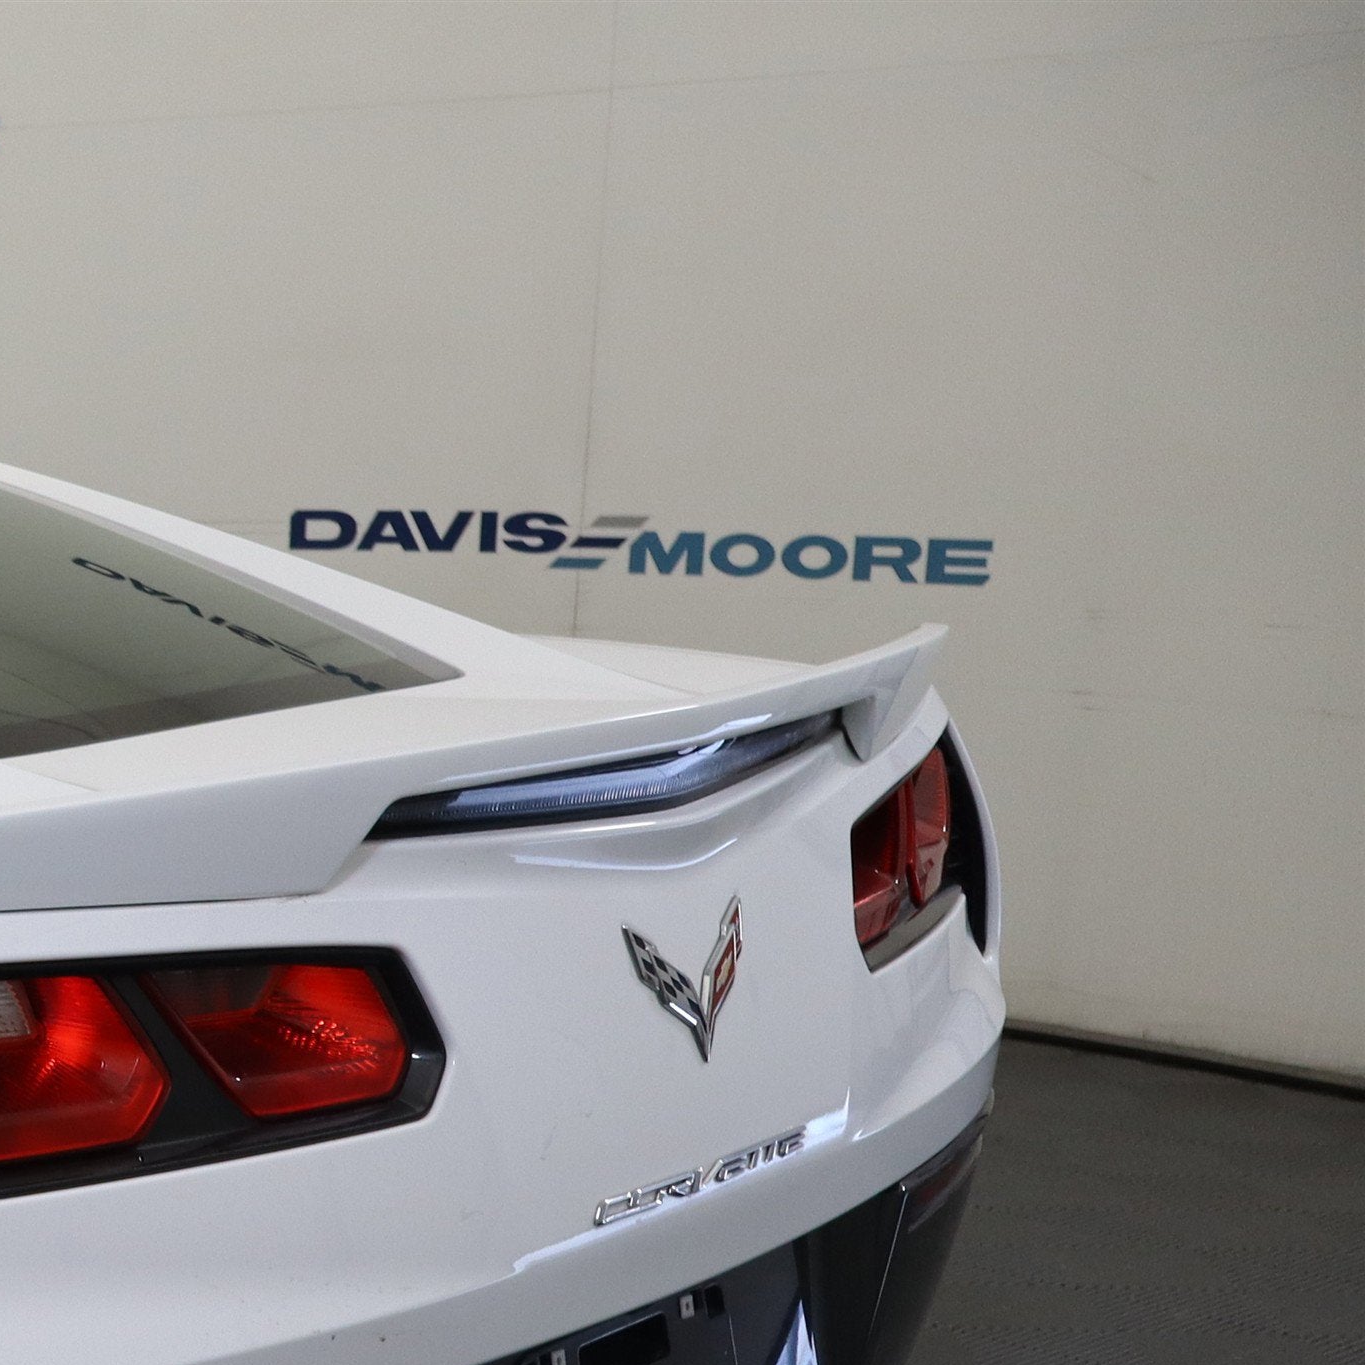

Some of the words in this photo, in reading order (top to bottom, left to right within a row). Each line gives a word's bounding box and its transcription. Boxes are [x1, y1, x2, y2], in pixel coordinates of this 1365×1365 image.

[287, 509, 570, 556] DAVIS
[627, 530, 995, 588] MOORE
[593, 1124, 808, 1227] CORVETTE
